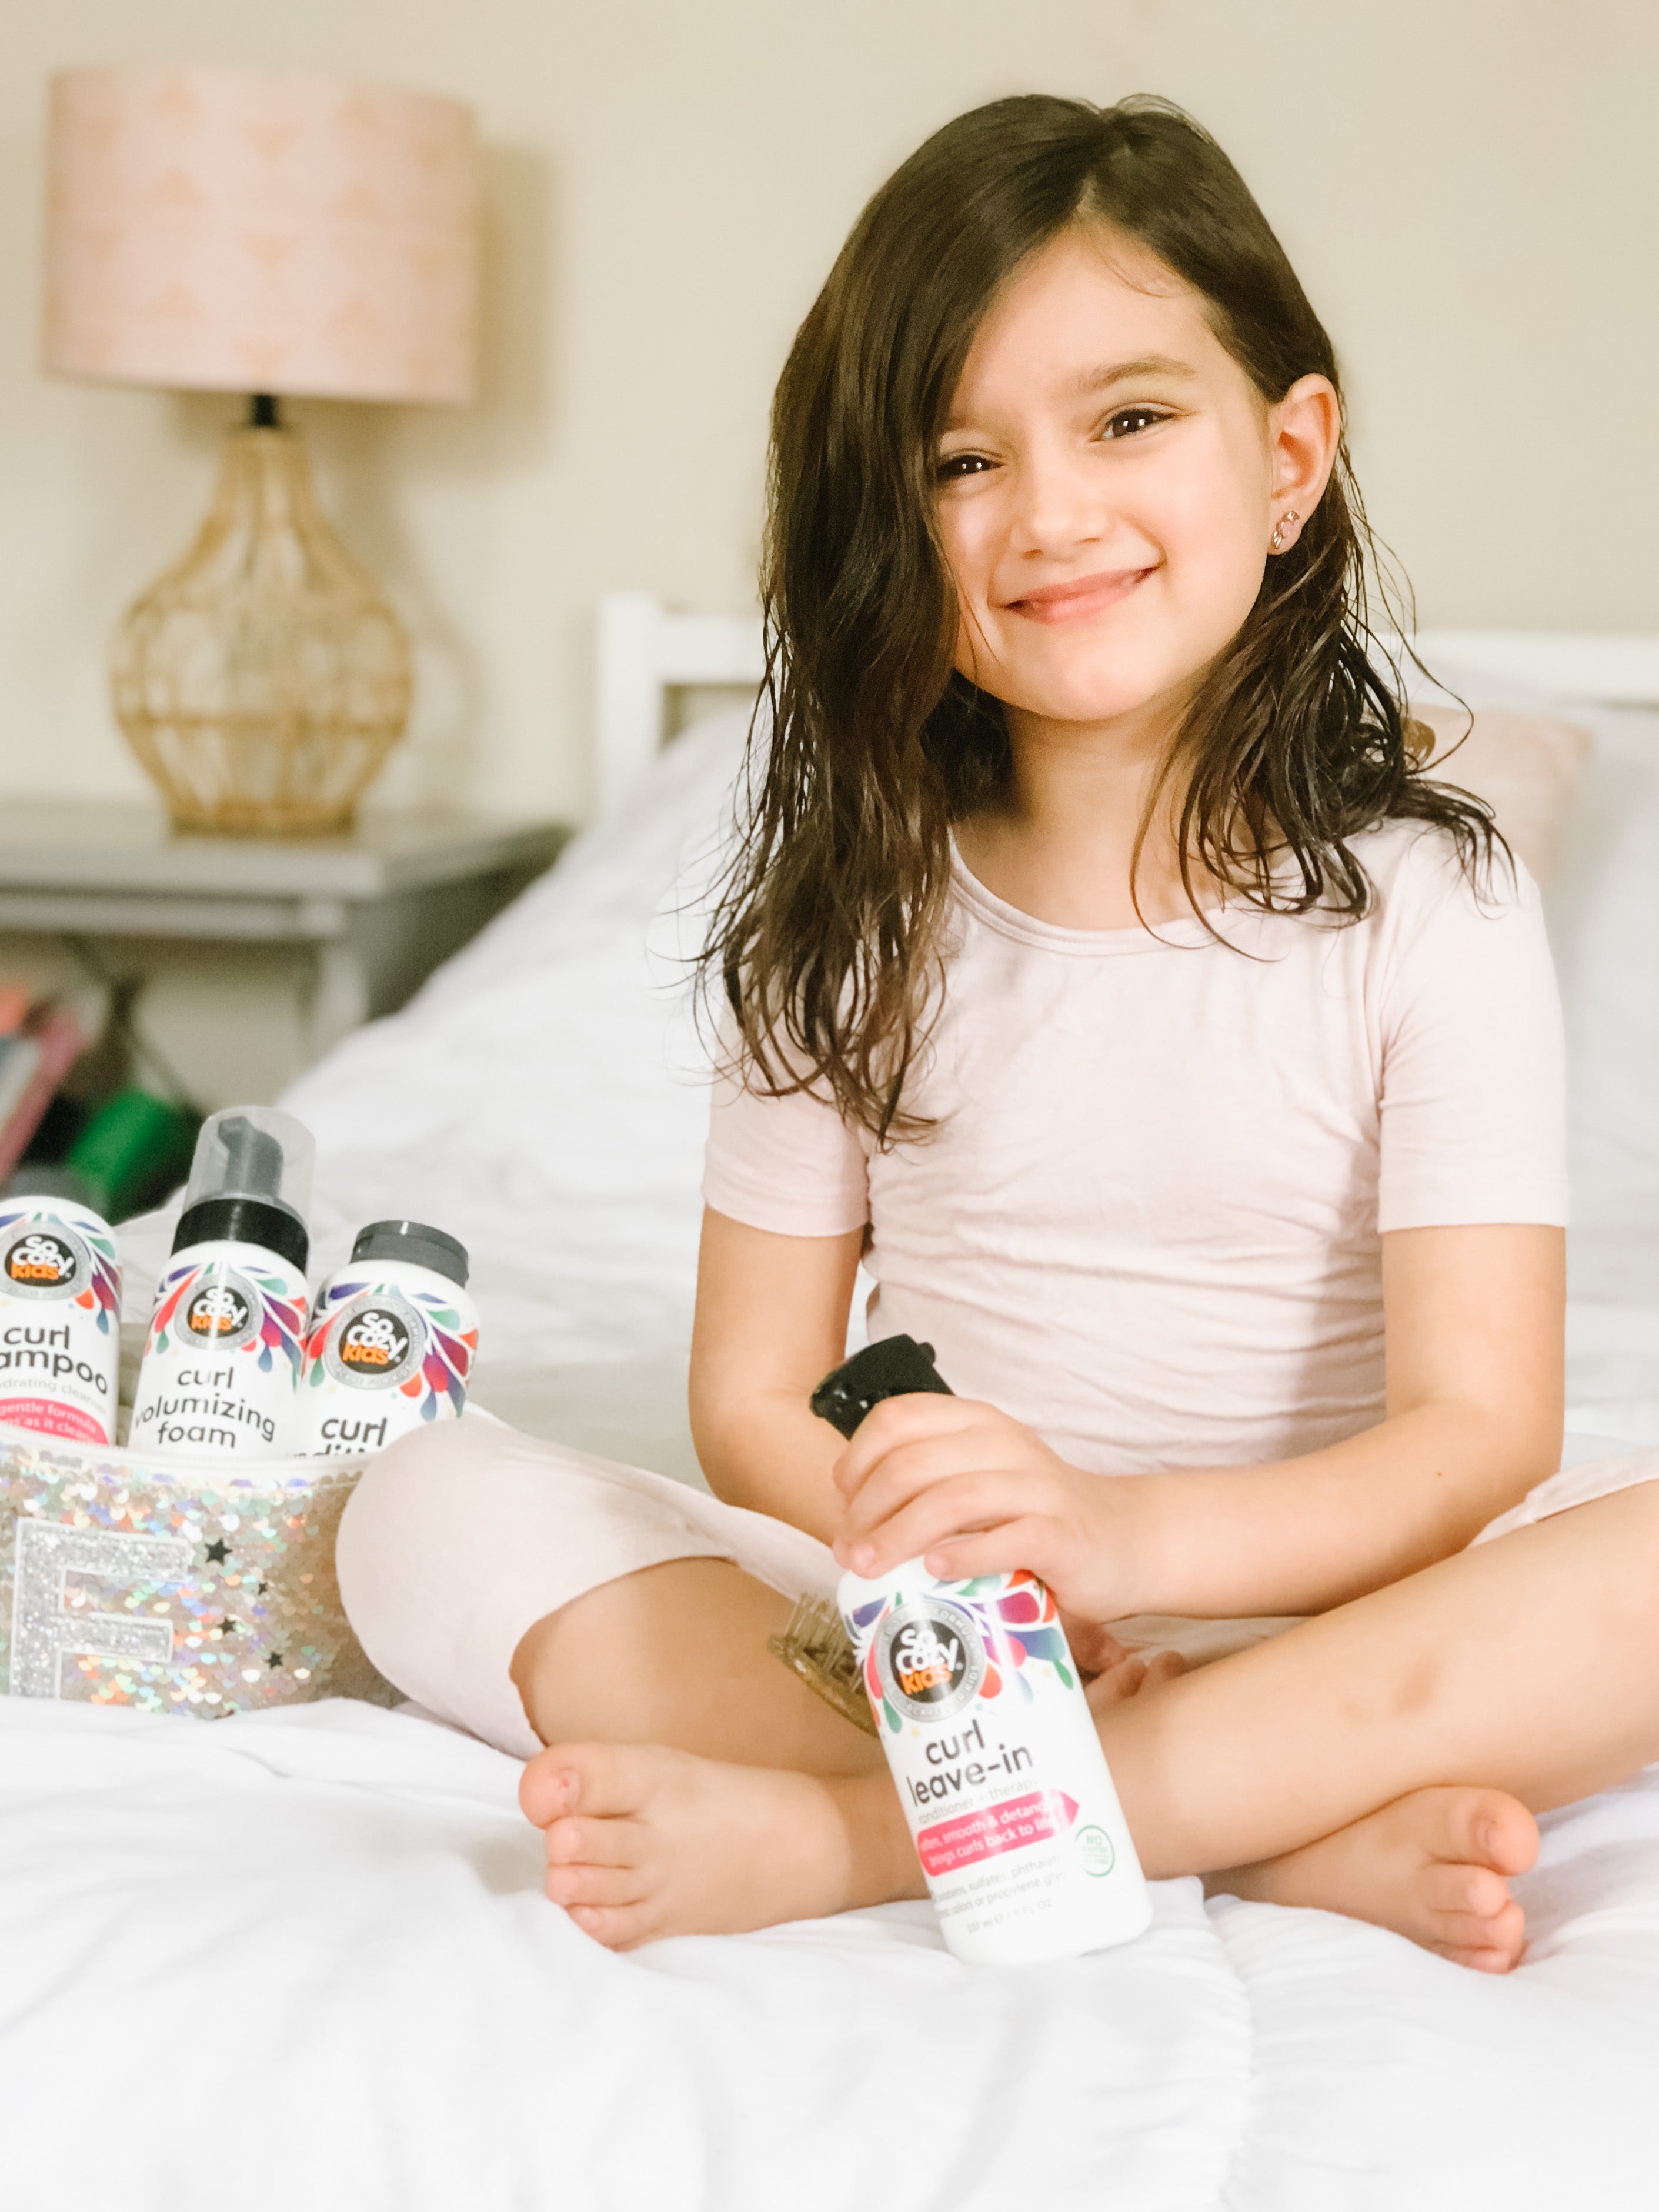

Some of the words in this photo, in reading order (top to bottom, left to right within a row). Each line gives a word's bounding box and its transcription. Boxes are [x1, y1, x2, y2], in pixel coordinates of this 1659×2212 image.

[3, 1324, 71, 1350] curl
[0, 1349, 108, 1396] ampoo
[177, 1367, 234, 1389] curl
[47, 1404, 96, 1434] formula
[135, 1393, 275, 1442] volumizing
[321, 1416, 388, 1447] curl
[158, 1421, 236, 1449] foam
[925, 1719, 985, 1765] curl
[906, 1743, 1033, 1807] leave-in
[942, 1820, 986, 1844] smooth
[986, 1815, 999, 1829] &
[956, 1839, 985, 1858] curls
[984, 1829, 1017, 1849] back
[1017, 1824, 1034, 1838] to
